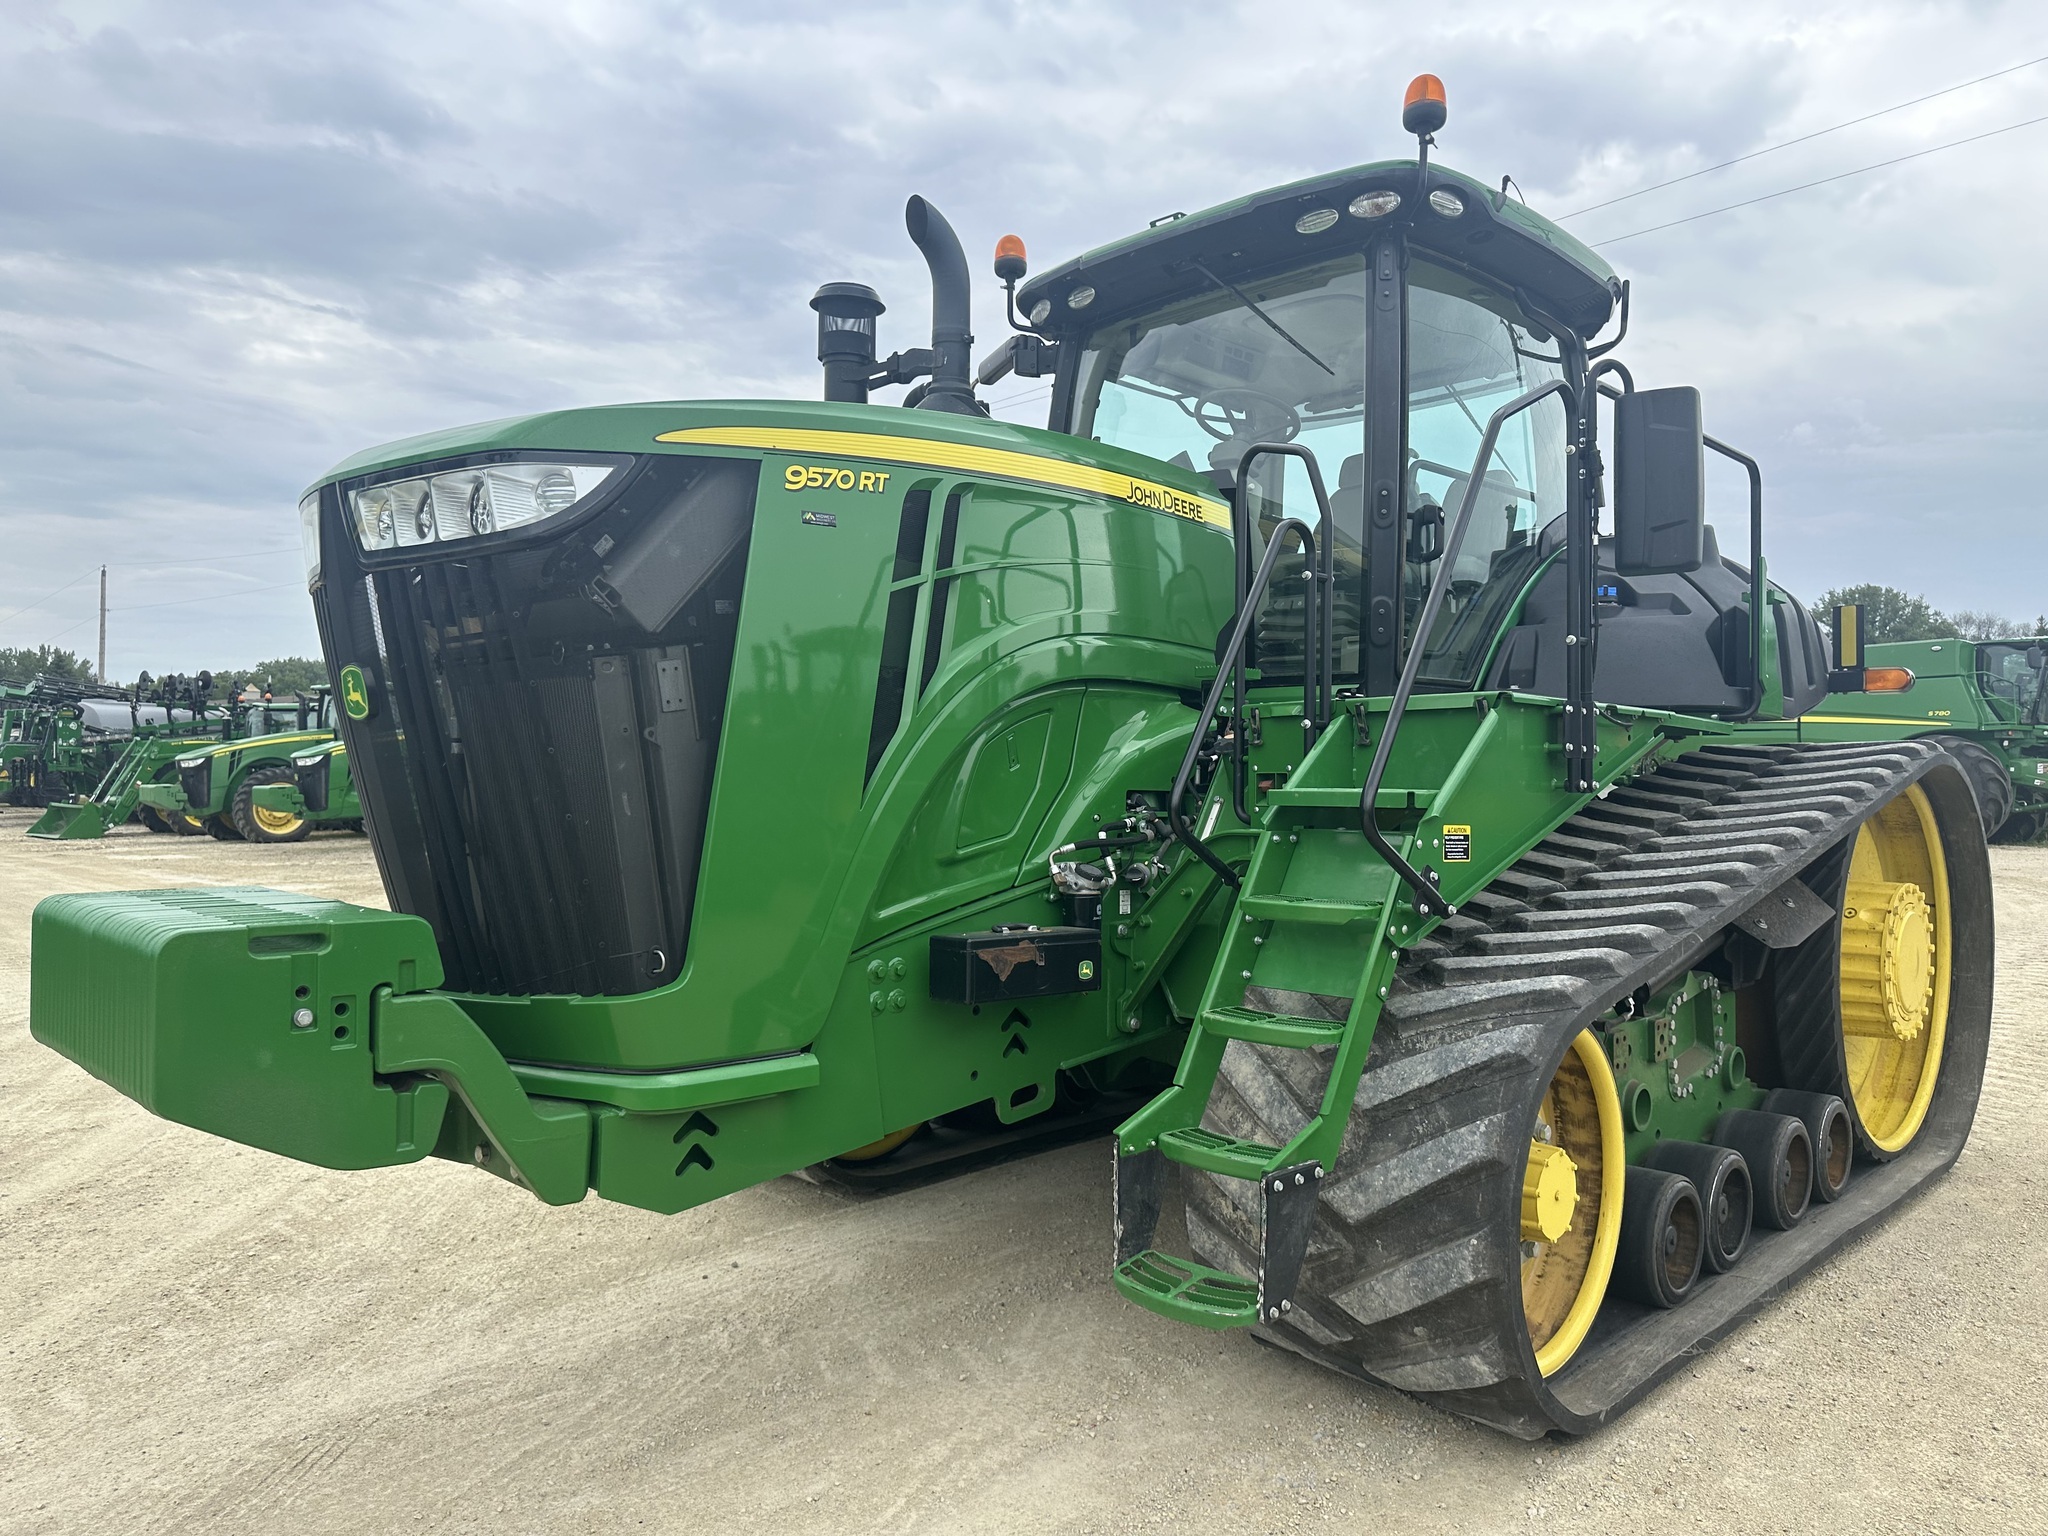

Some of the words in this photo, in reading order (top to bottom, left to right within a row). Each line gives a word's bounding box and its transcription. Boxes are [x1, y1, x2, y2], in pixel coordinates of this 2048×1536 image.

[784, 464, 856, 491] 9570
[858, 471, 890, 493] RT
[1126, 481, 1163, 510] JOHN
[1163, 490, 1204, 521] DEERE
